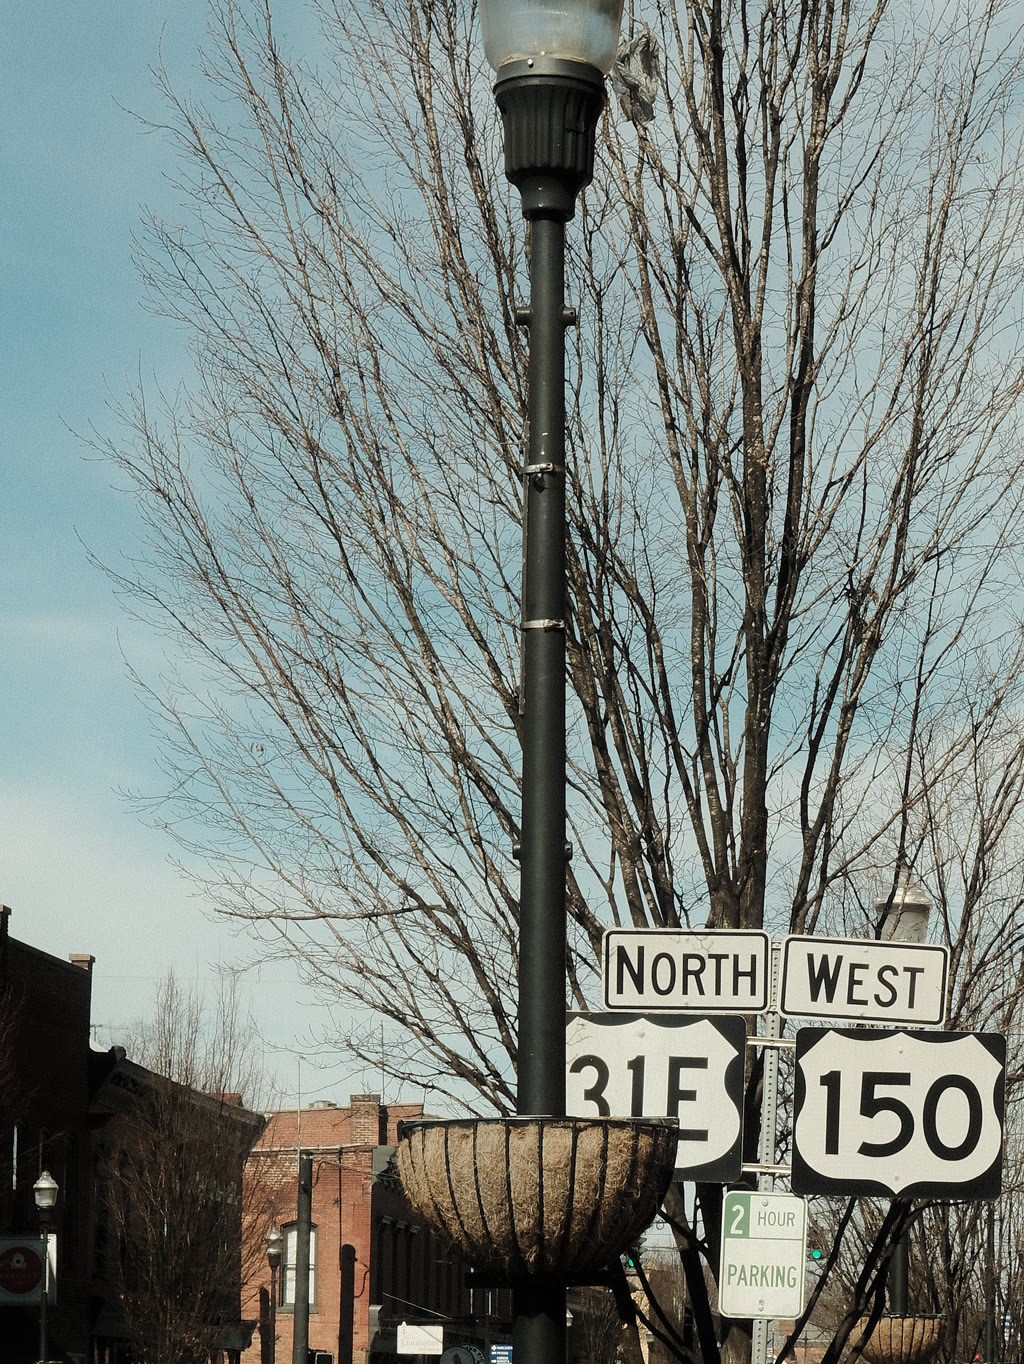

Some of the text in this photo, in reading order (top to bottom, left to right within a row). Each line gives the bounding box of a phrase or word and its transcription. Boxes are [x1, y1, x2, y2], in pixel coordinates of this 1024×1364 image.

[616, 945, 757, 996] NORTH
[806, 953, 925, 1009] WEST
[569, 1054, 709, 1142] 31E
[819, 1070, 983, 1161] 150
[730, 1204, 796, 1235] 2 HOUR
[727, 1264, 798, 1289] PARKING
